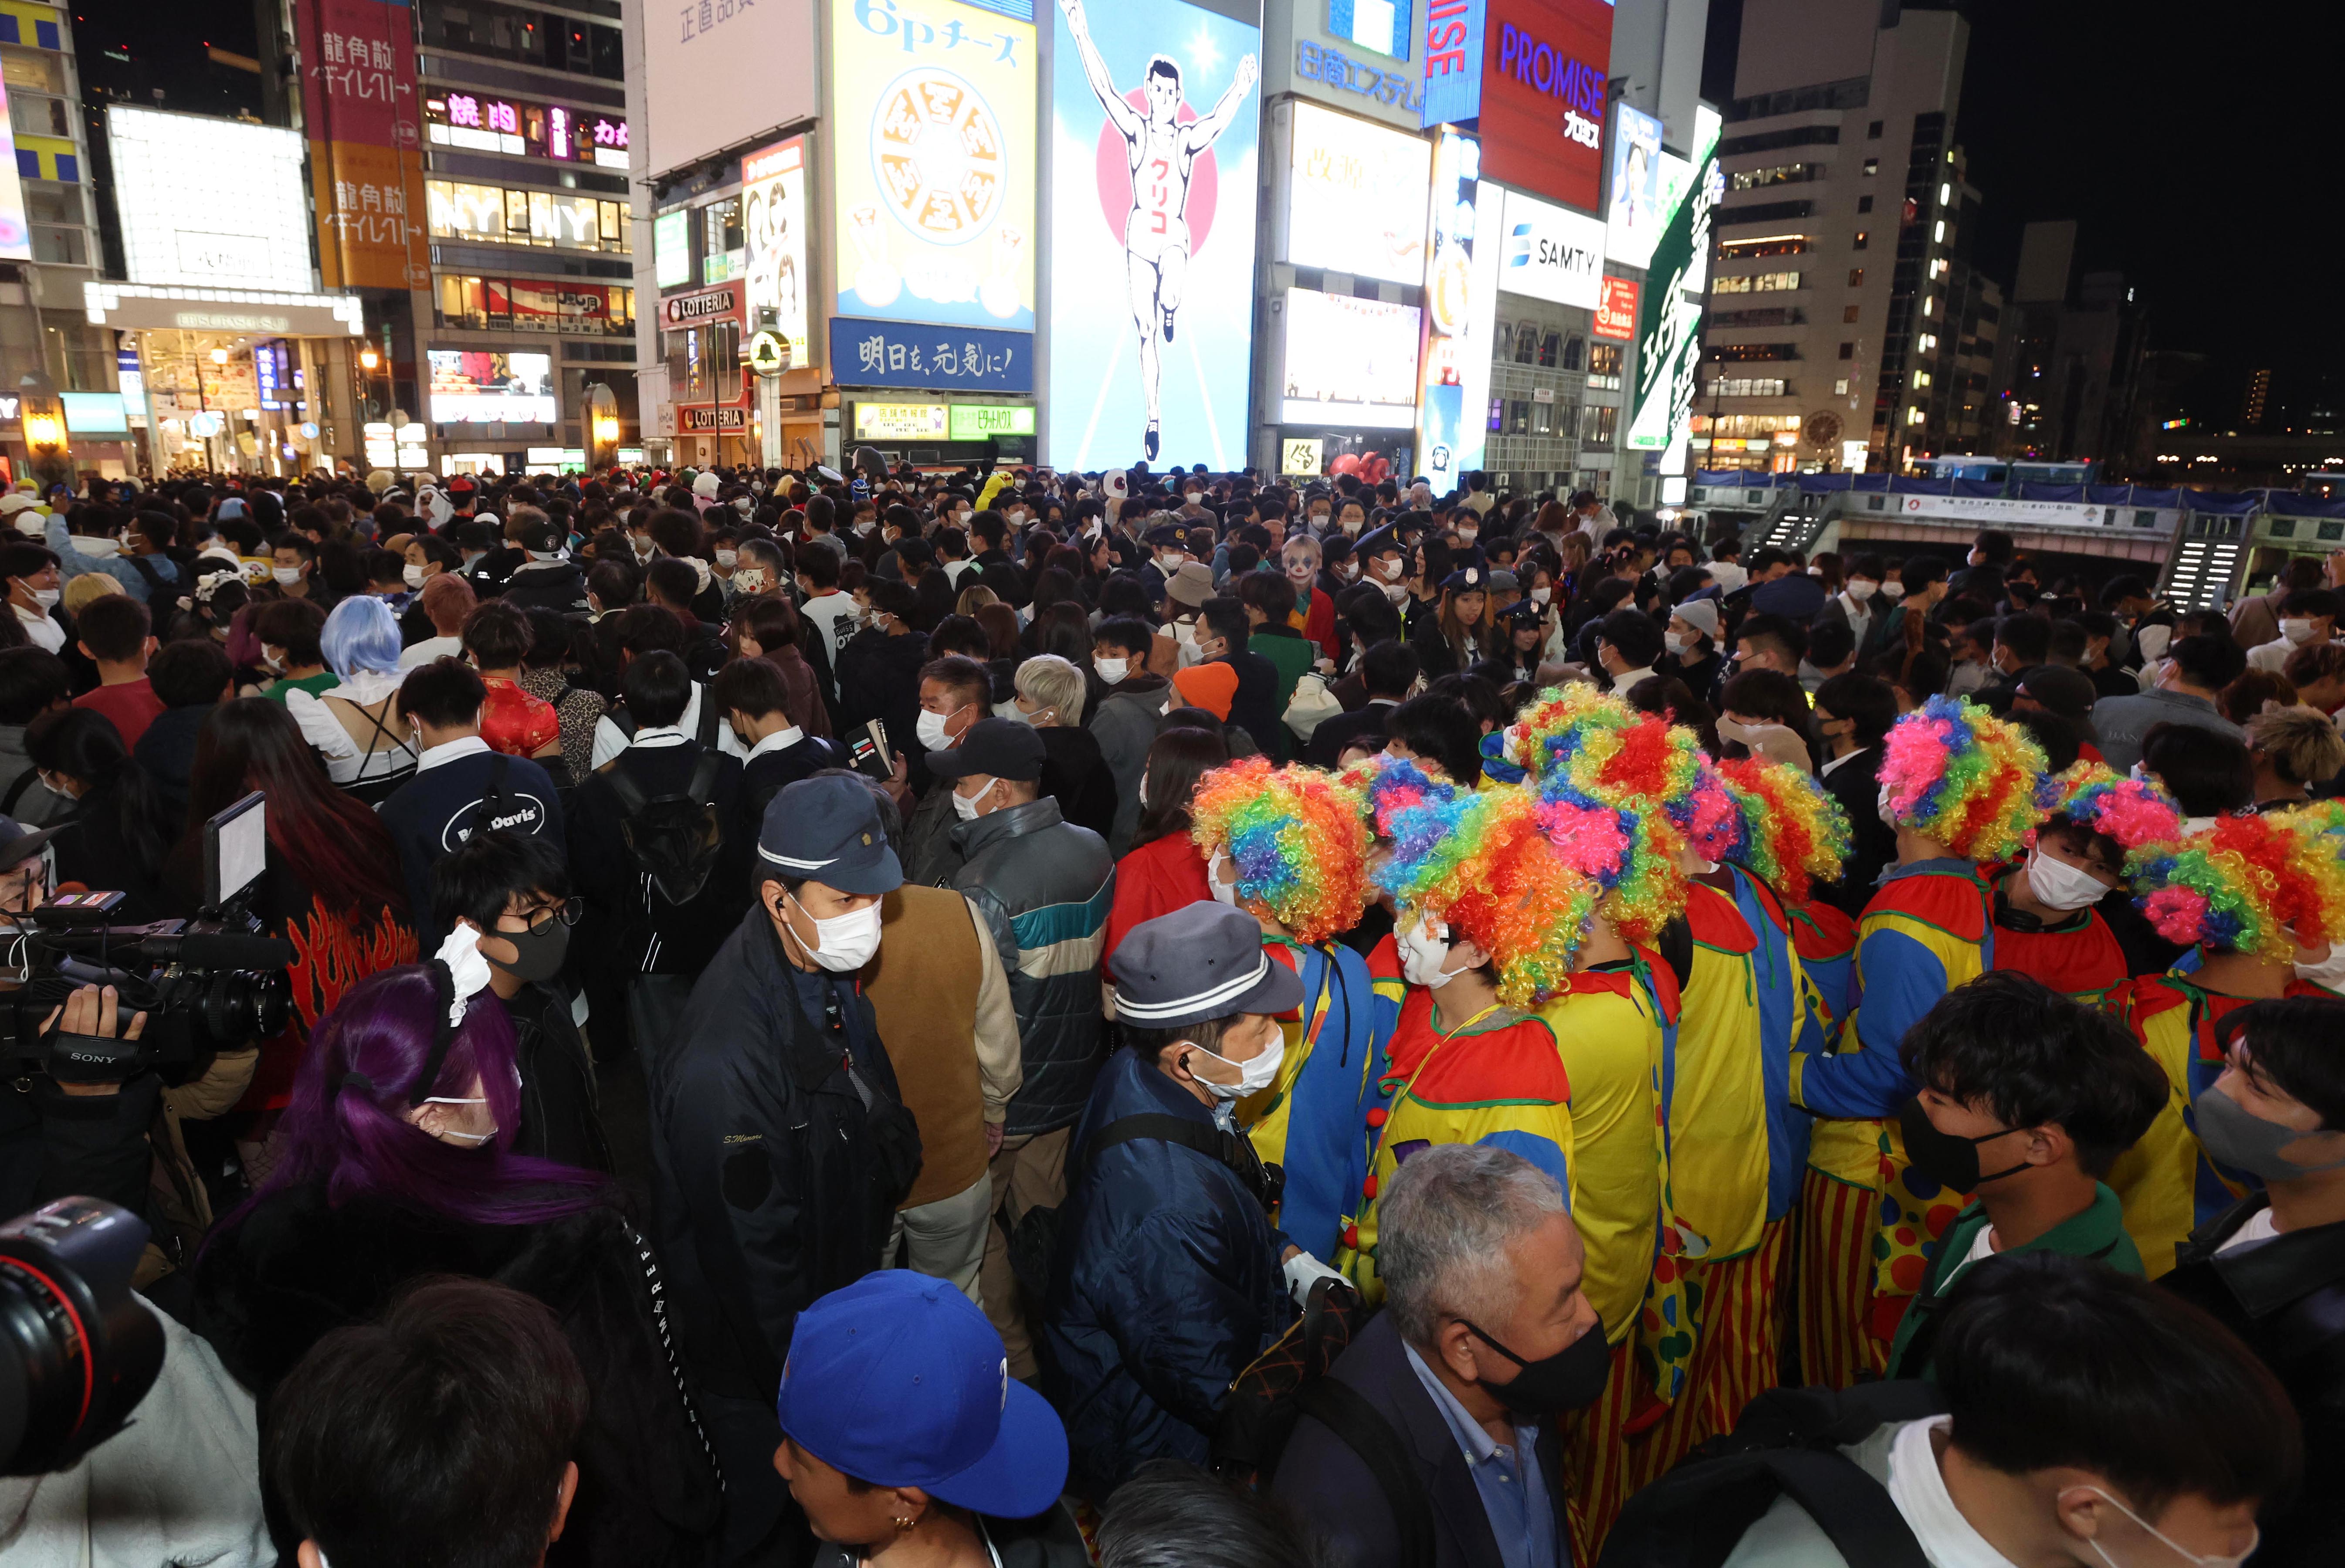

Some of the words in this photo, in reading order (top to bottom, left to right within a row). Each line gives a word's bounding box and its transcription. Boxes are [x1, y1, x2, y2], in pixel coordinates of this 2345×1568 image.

[323, 31, 394, 69] 龍角散
[1426, 0, 1467, 78] ISE
[1501, 23, 1606, 117] PROMISE
[449, 93, 517, 132] 焼肉
[1563, 110, 1599, 149] プロミス
[335, 179, 405, 214] 龍角散
[1150, 156, 1171, 234] グリコ
[1539, 238, 1596, 275] SAMTY
[681, 292, 731, 317] LOTTERIA
[858, 335, 1013, 378] 明日を、元気に!
[695, 410, 741, 427] LOTTERIA
[879, 408, 928, 418] 店舗情報館
[836, 624, 853, 635] GUESS
[491, 809, 536, 830] Davis
[71, 1052, 117, 1065] SONY
